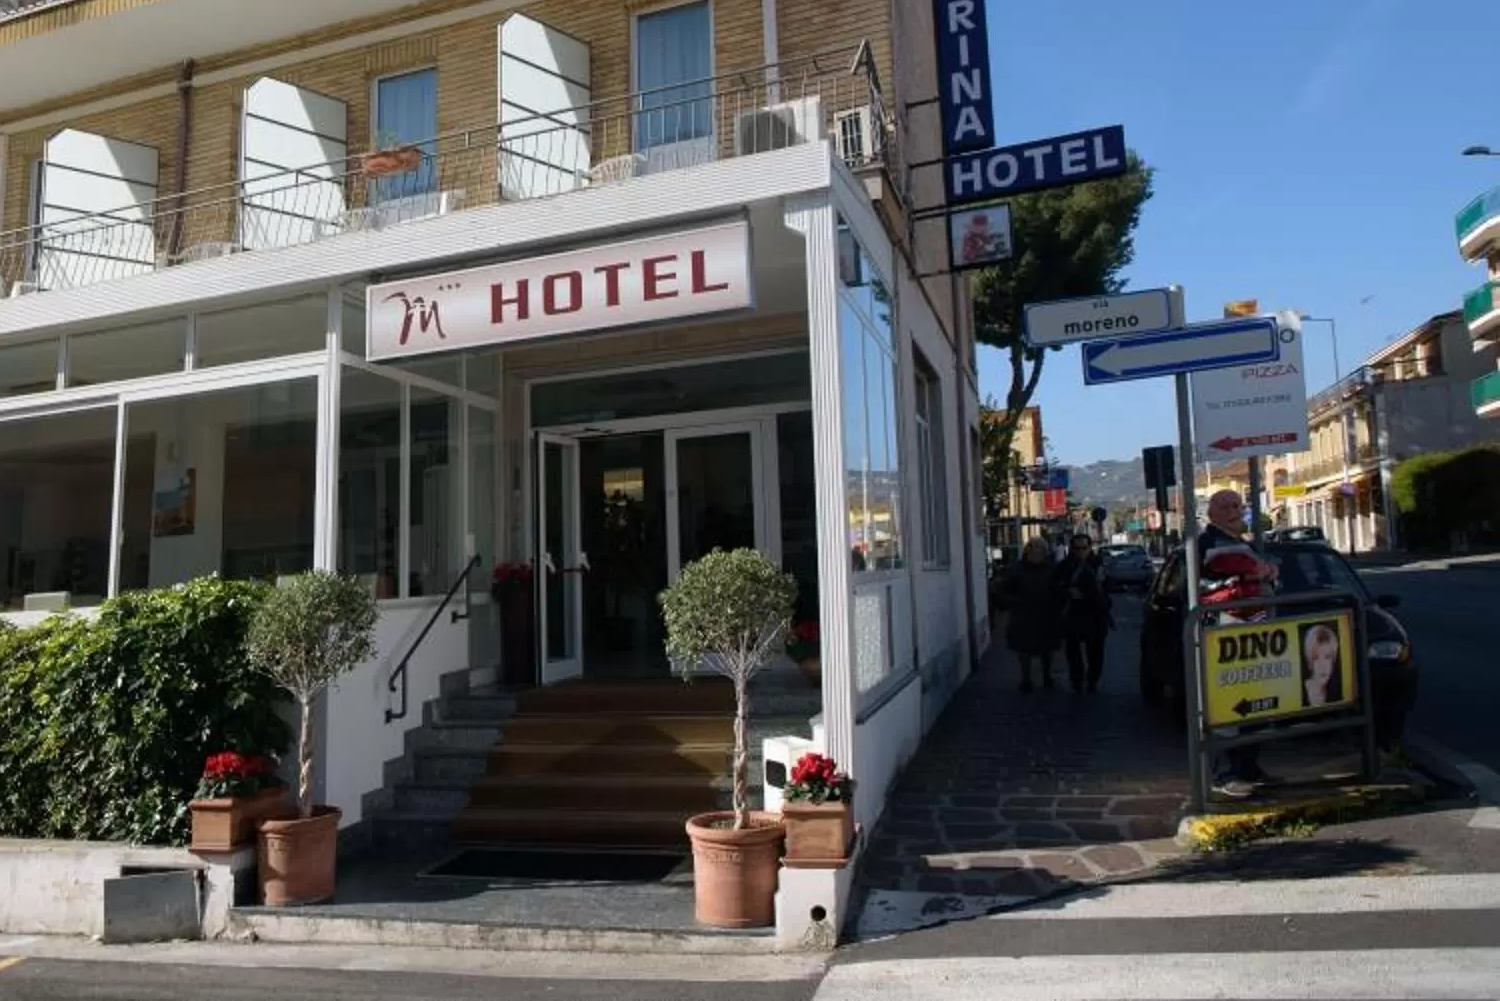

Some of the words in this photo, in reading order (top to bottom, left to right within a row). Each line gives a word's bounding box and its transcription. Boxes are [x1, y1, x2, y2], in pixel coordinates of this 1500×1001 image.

[952, 135, 1119, 196] HOTEL
[490, 249, 729, 325] HOTEL
[1063, 314, 1140, 335] moreno
[1242, 362, 1300, 380] PIZZA
[1218, 629, 1288, 663] DINO
